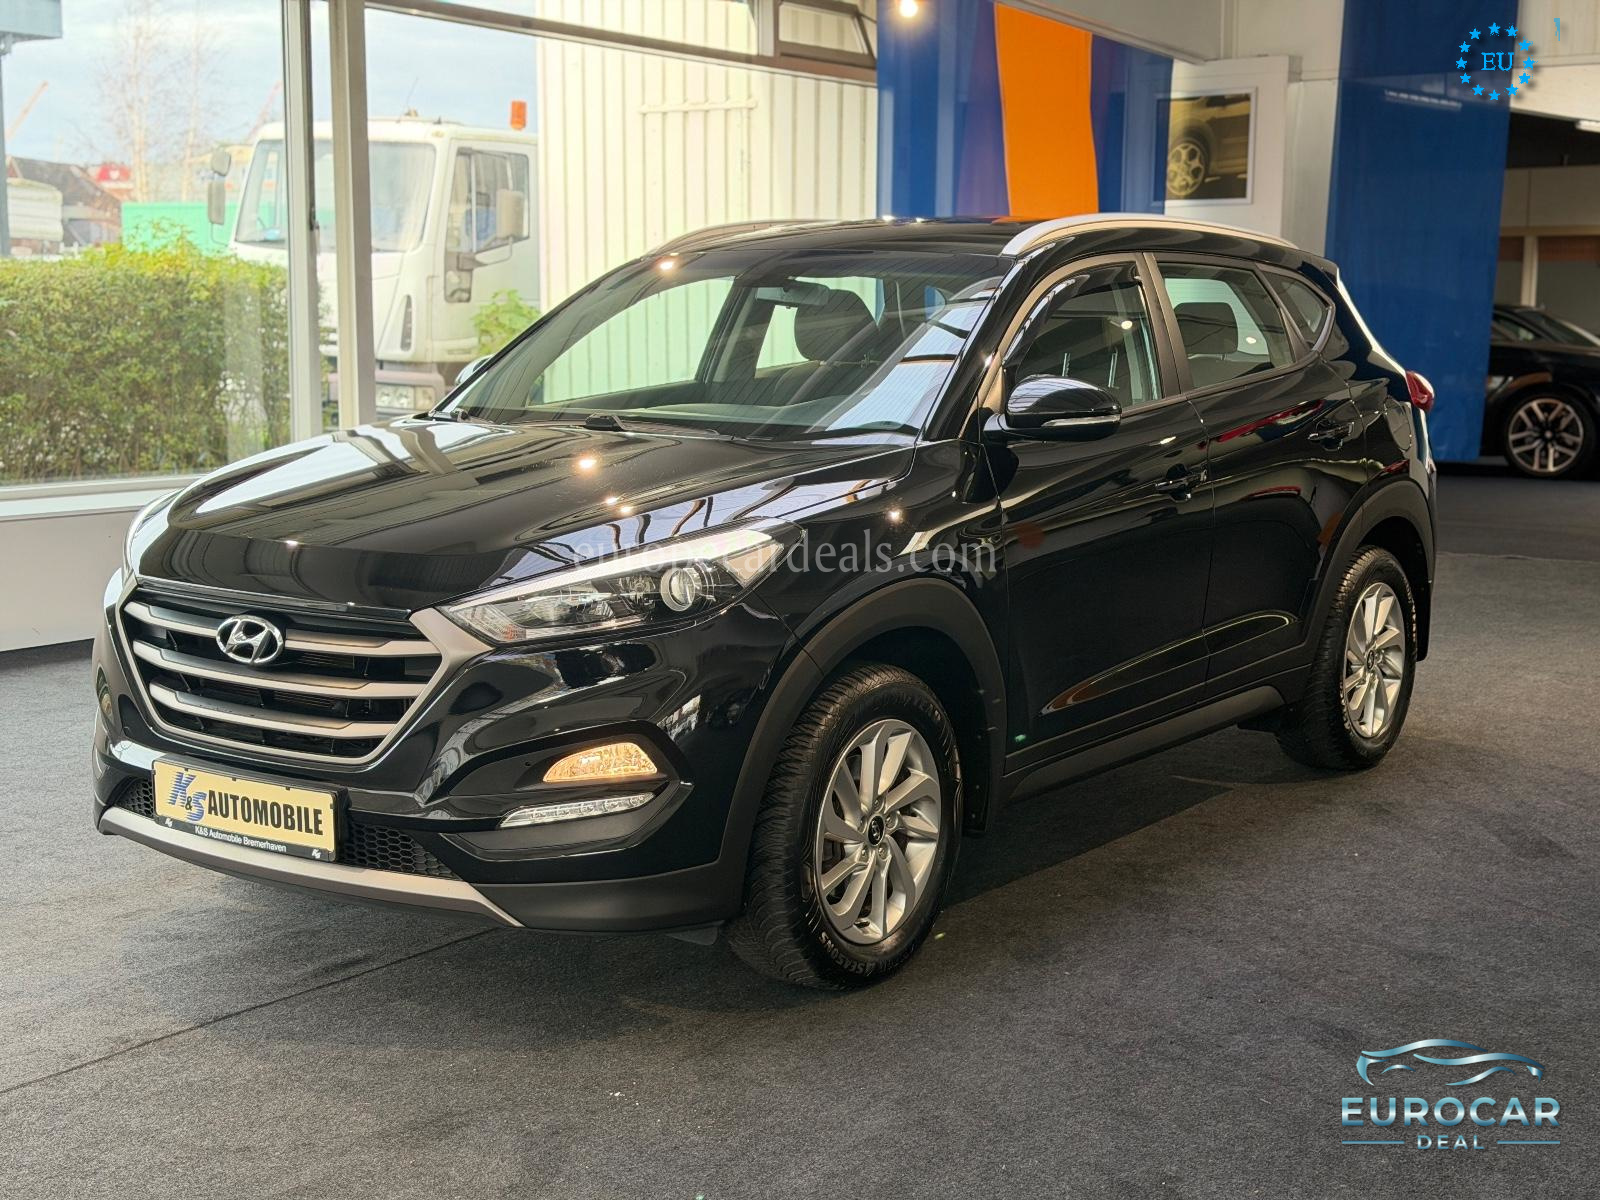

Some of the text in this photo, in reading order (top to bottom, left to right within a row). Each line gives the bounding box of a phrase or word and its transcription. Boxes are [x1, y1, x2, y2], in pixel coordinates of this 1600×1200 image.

[208, 790, 323, 836] AUTOMOBILE
[194, 825, 287, 852] K&S Automobile Bremerhaven
